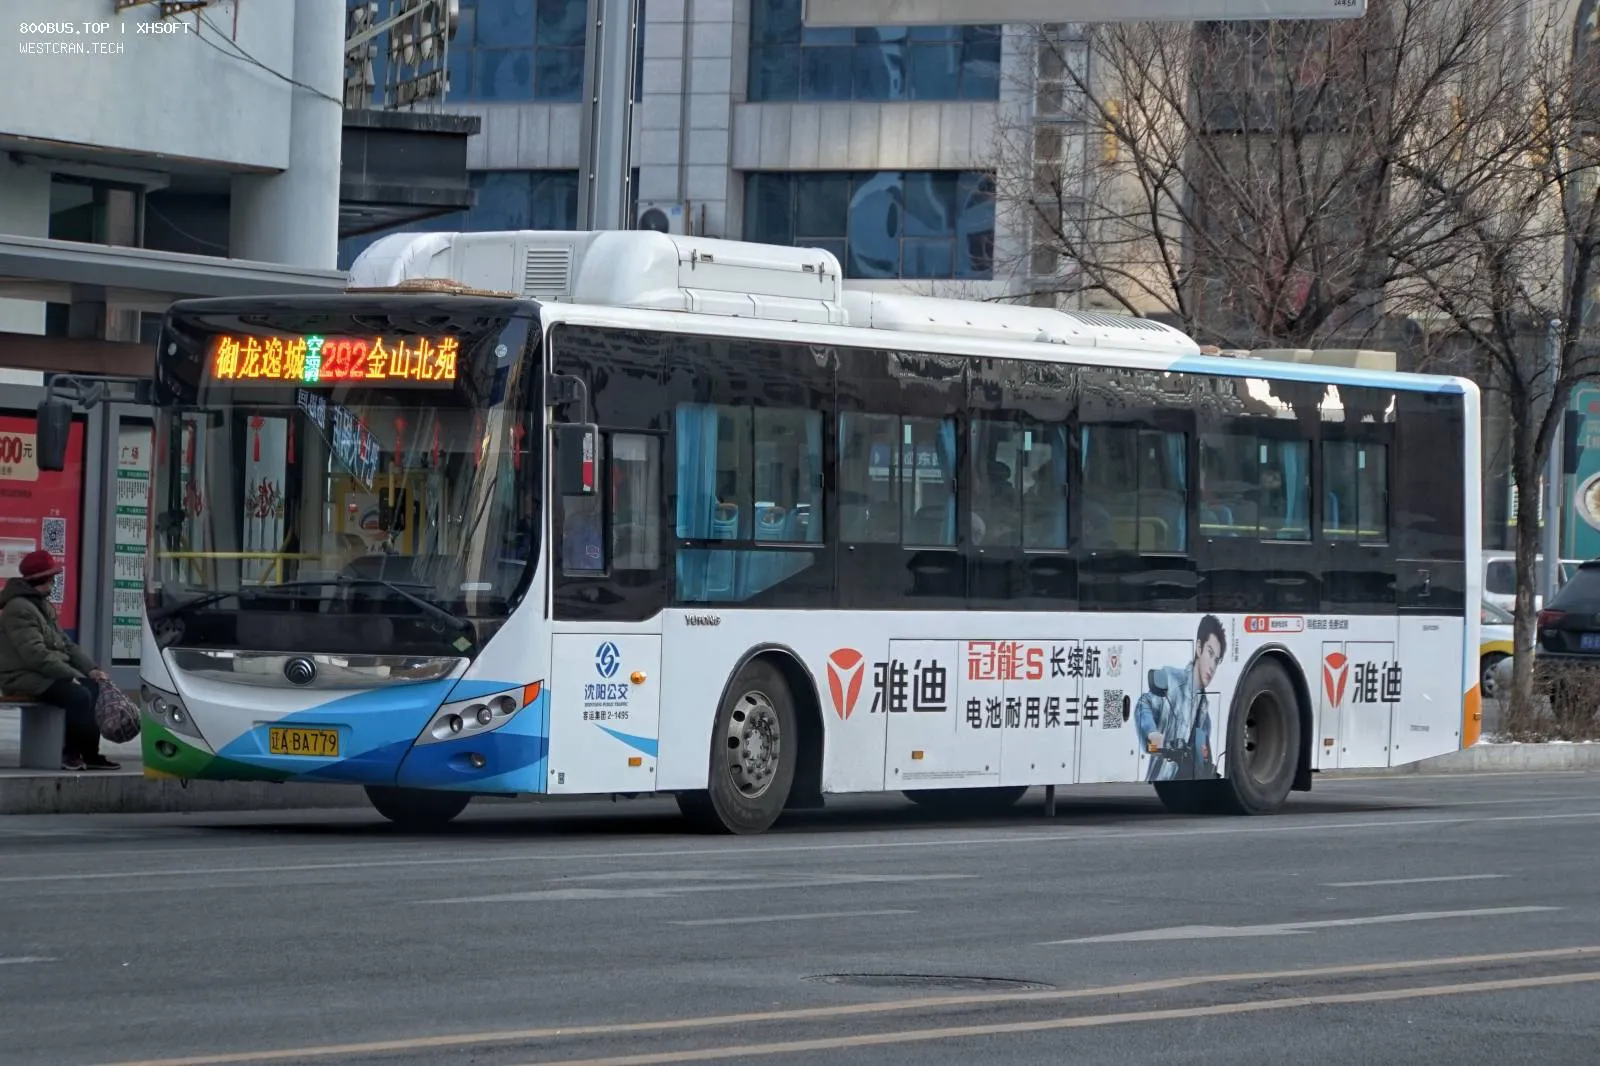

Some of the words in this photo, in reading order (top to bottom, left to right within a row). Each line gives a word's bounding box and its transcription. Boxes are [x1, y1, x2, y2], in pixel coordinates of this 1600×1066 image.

[318, 341, 367, 378] 292
[366, 337, 458, 379] 金山北苑
[967, 640, 1043, 681] 冠能S
[1050, 645, 1101, 679] 长续航
[584, 683, 629, 701] 沈阳公交
[870, 658, 948, 713] 雅迪
[1352, 661, 1402, 703] 雅迪
[965, 695, 1099, 730] 电池耐用保三年
